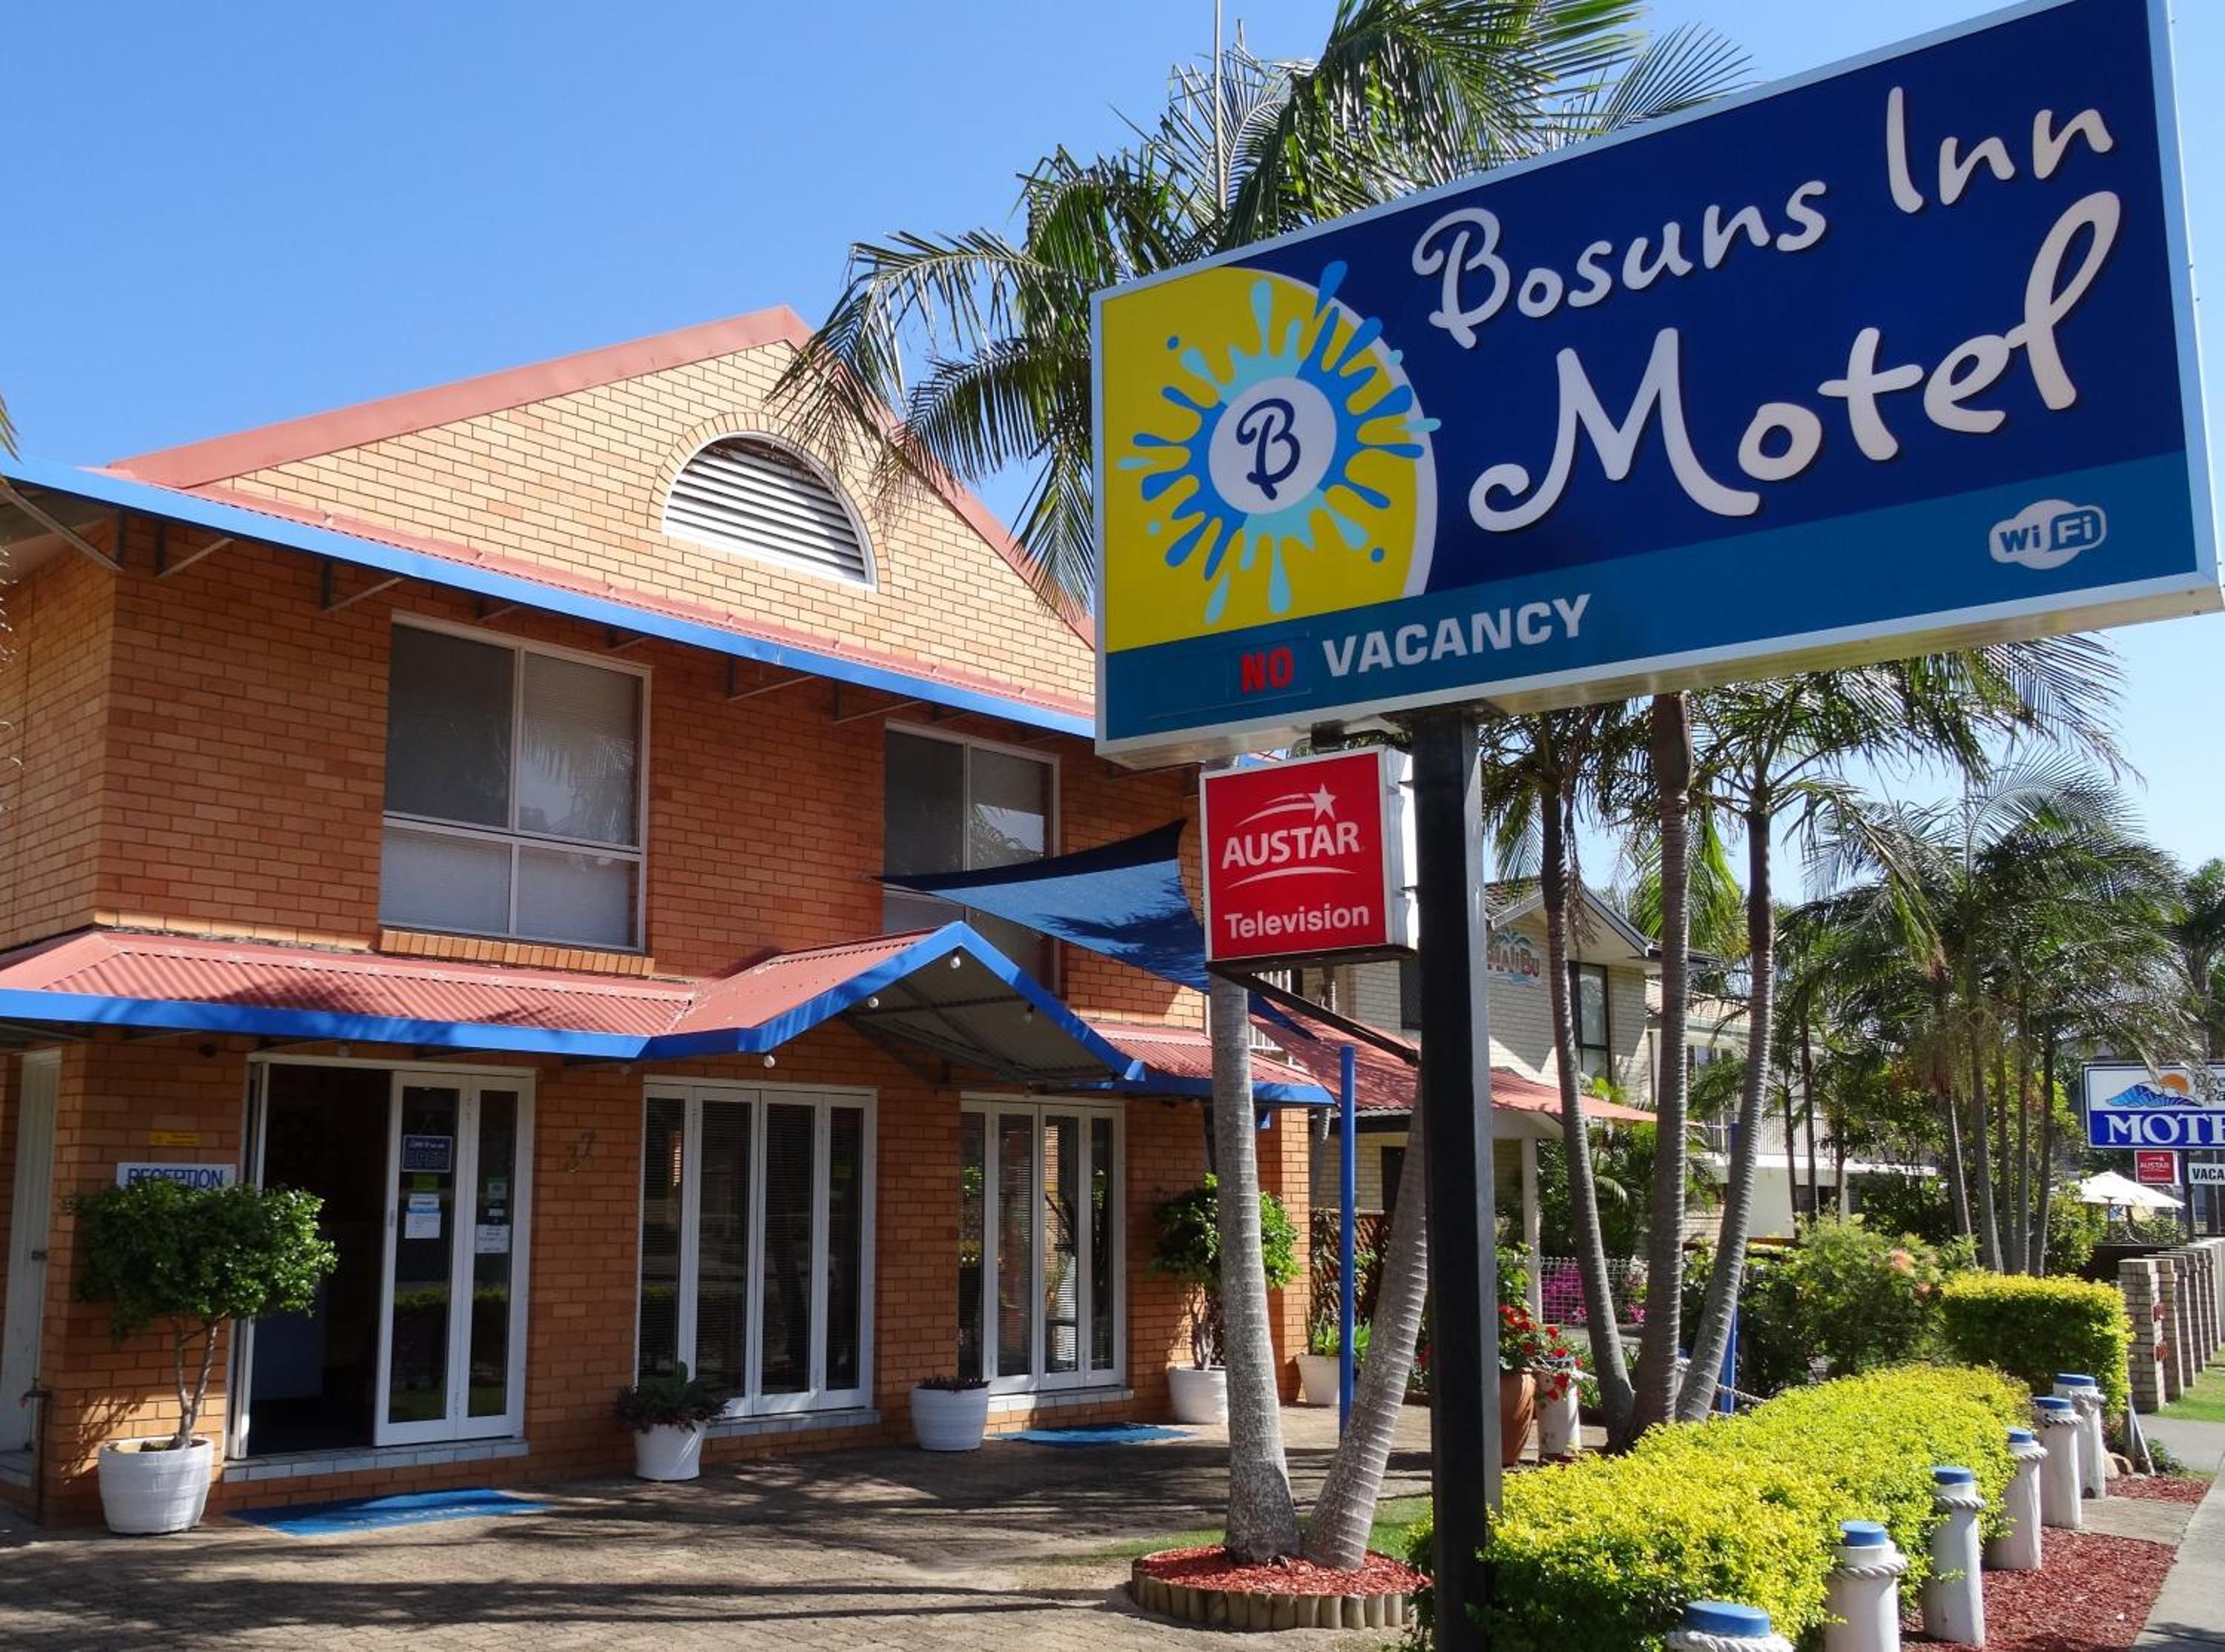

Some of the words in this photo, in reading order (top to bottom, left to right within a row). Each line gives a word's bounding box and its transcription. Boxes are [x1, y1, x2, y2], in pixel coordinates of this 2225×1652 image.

[1411, 179, 1827, 350] Bosuns
[1886, 85, 2114, 214] Inn
[1468, 190, 2121, 532] Motel
[1236, 397, 1302, 501] B
[1240, 644, 1295, 695] NO
[1322, 592, 1592, 678] VACANCY
[1222, 820, 1360, 870] AUSTAR
[1224, 902, 1371, 939] Television
[2104, 1113, 2225, 1144] MOTE
[2192, 1168, 2225, 1180] VACA
